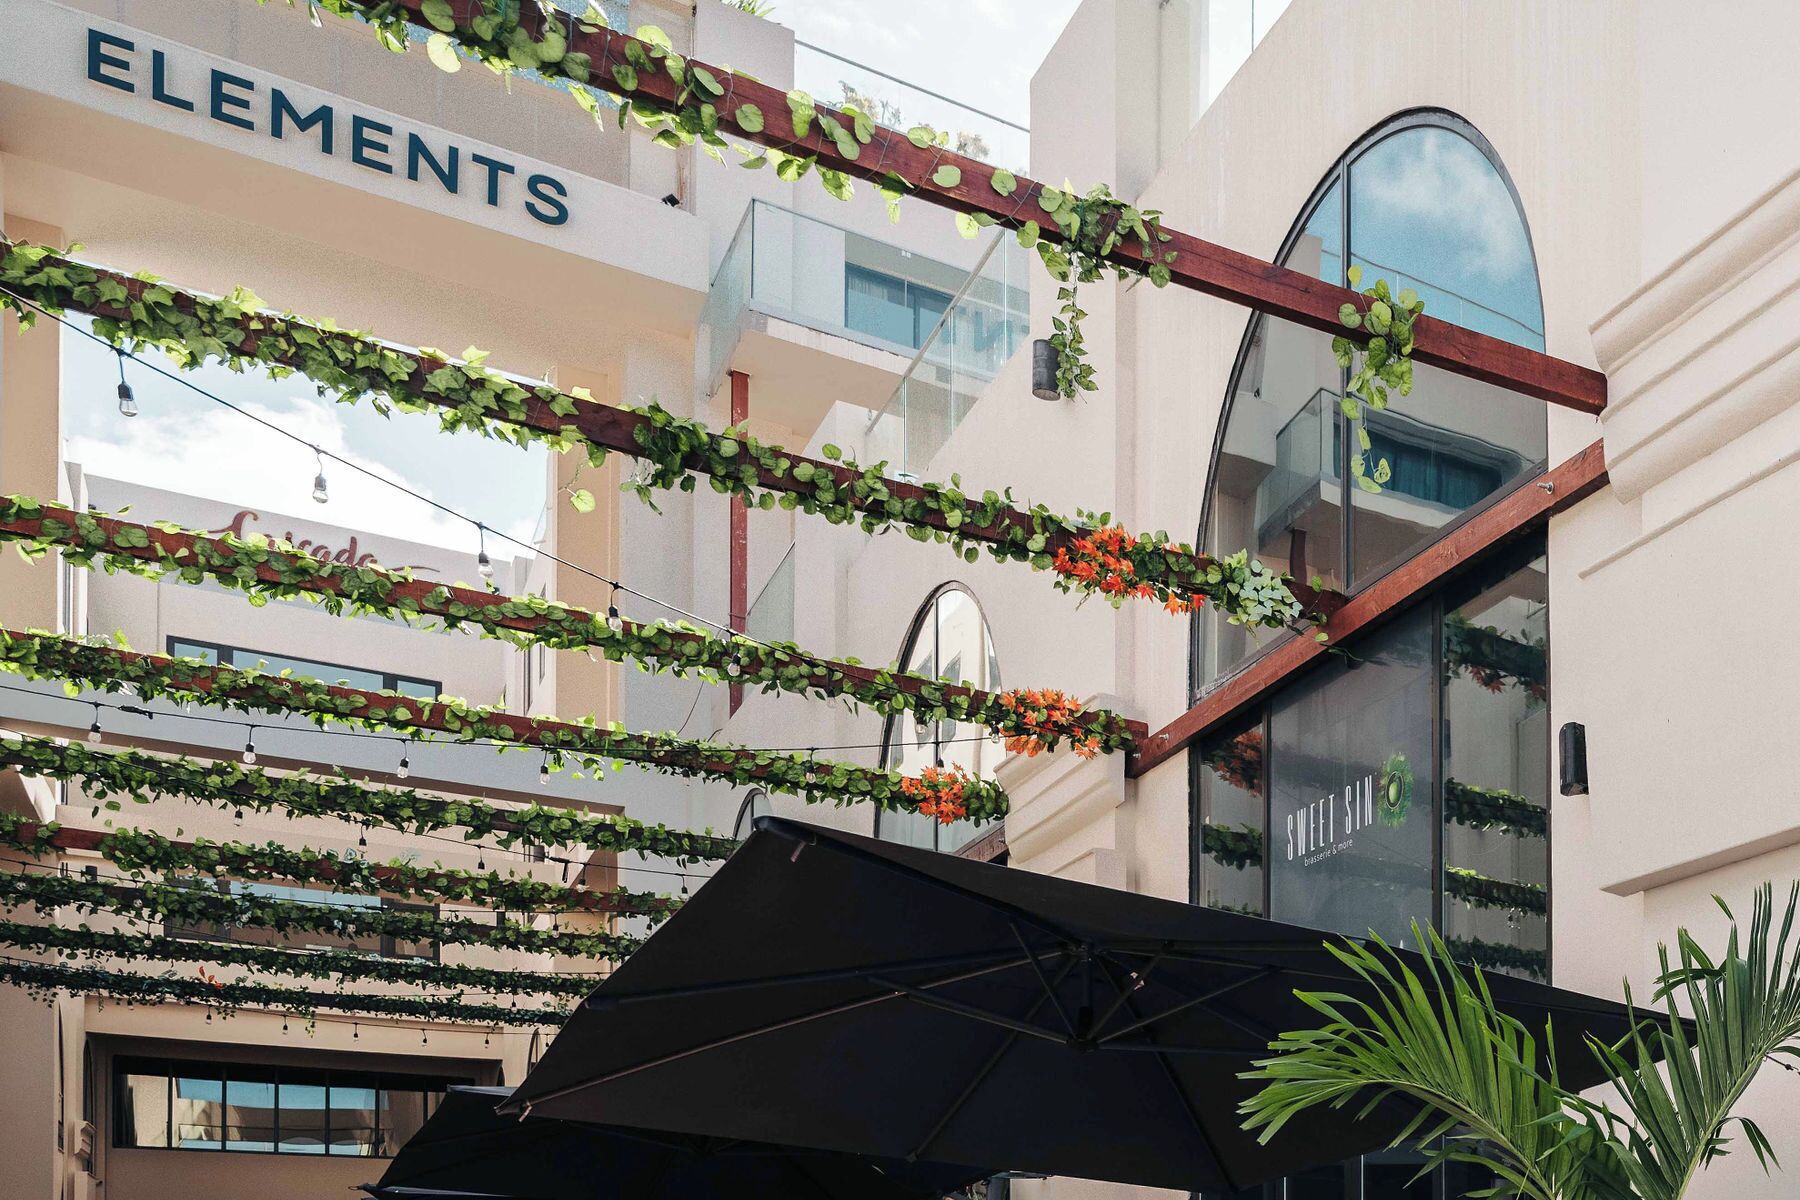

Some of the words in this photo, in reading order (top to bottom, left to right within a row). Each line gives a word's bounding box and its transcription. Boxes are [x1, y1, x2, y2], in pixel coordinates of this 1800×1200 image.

[87, 28, 570, 226] ELEMENTS
[1287, 794, 1335, 861] SWEET
[1345, 774, 1373, 834] SIN
[1304, 848, 1331, 867] brasserie
[1332, 845, 1337, 855] &
[1337, 839, 1353, 852] more
